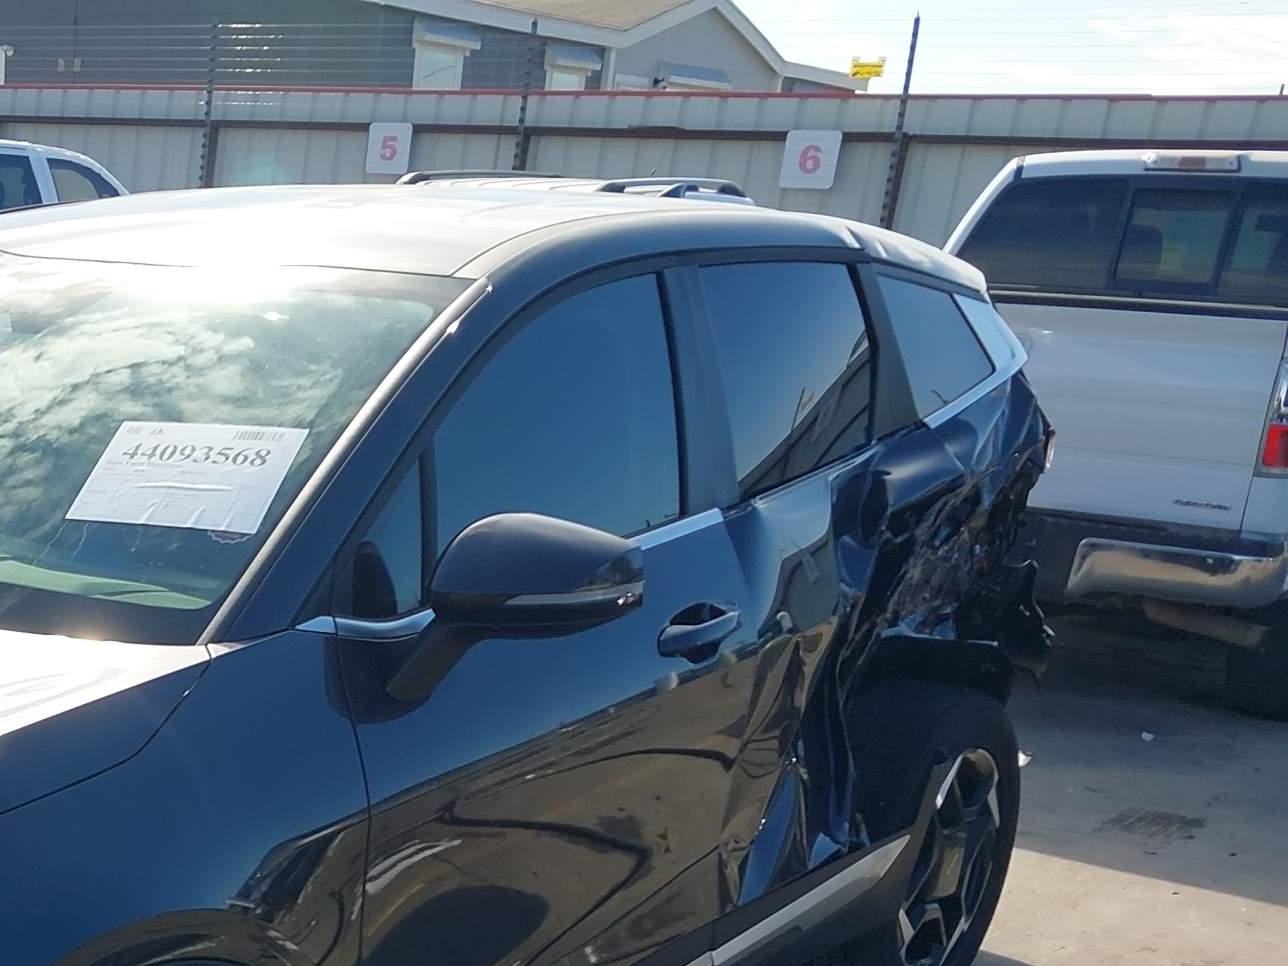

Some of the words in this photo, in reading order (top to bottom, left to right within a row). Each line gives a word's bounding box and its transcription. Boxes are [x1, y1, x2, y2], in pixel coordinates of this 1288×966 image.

[380, 135, 398, 161] 5
[799, 144, 822, 174] 6
[122, 442, 272, 468] 44093568
